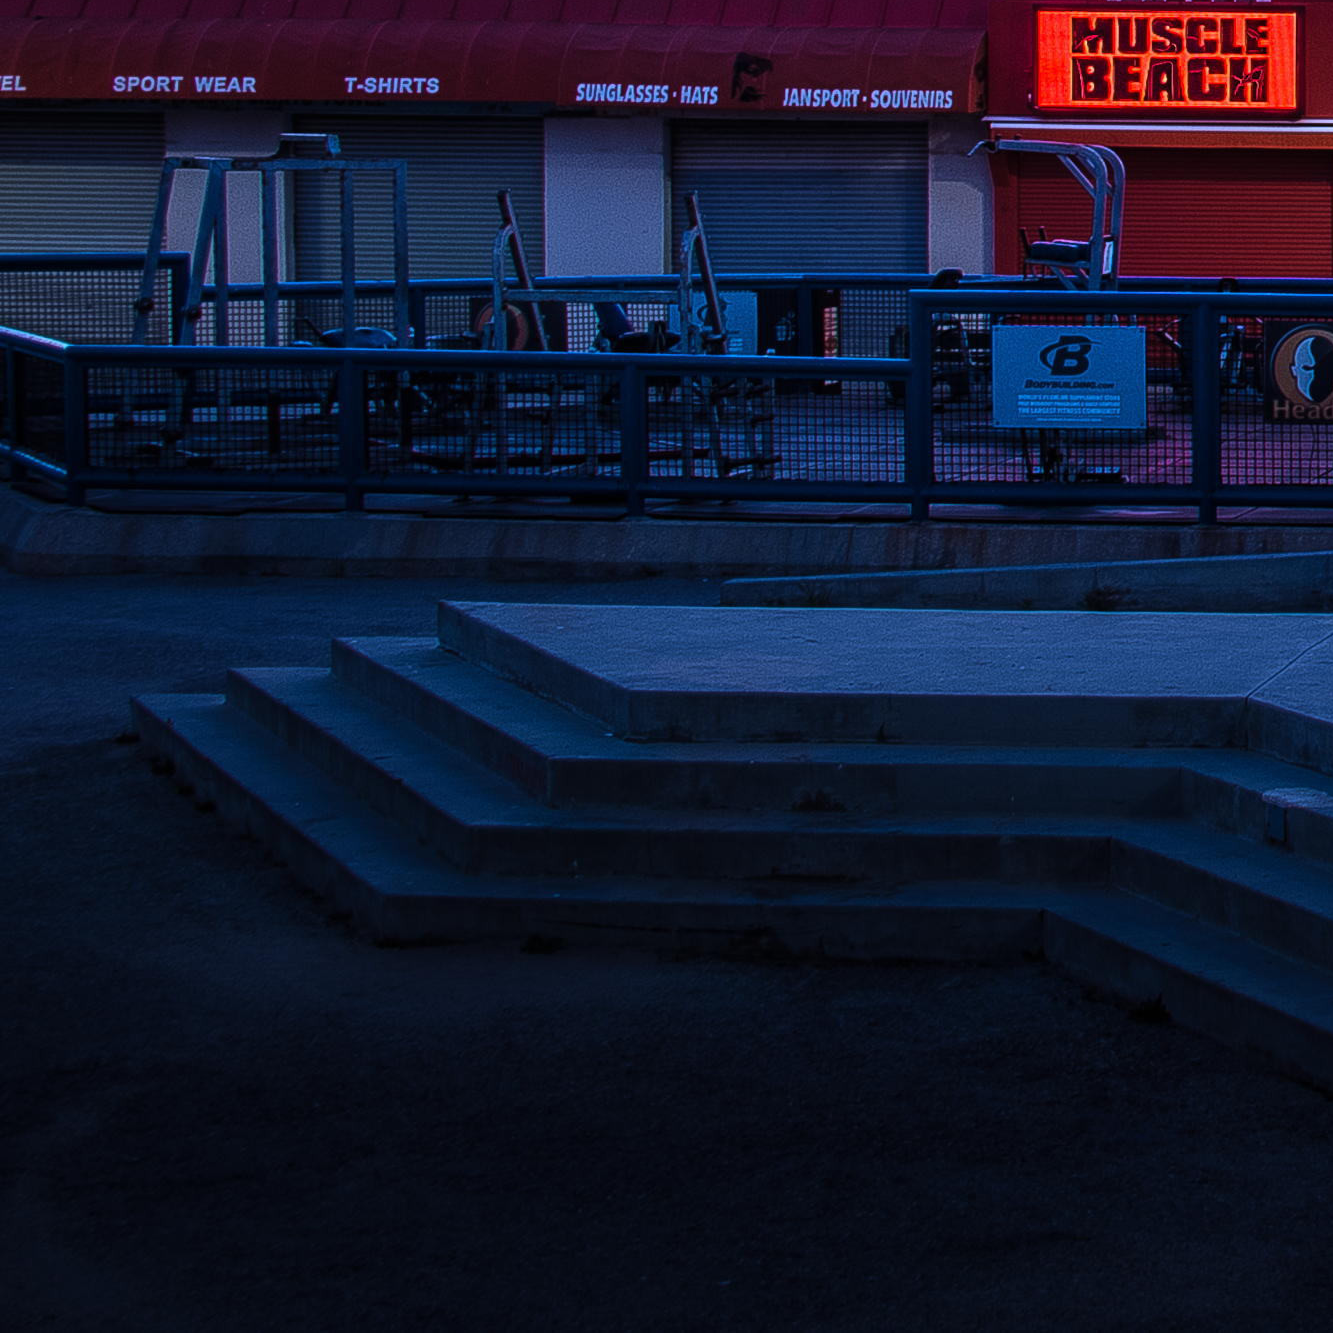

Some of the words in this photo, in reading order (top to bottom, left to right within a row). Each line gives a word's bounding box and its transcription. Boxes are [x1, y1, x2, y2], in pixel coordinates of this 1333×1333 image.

[1071, 16, 1270, 55] MUSCLE
[0, 75, 27, 91] EL
[112, 76, 183, 93] SPORT
[194, 77, 257, 93] WEAR
[344, 77, 440, 94] T-SHIRTS
[1071, 57, 1270, 103] BEACH
[575, 83, 669, 104] SUNGLASSES
[680, 86, 719, 105] HATS
[870, 89, 953, 109] SOUVENIRS
